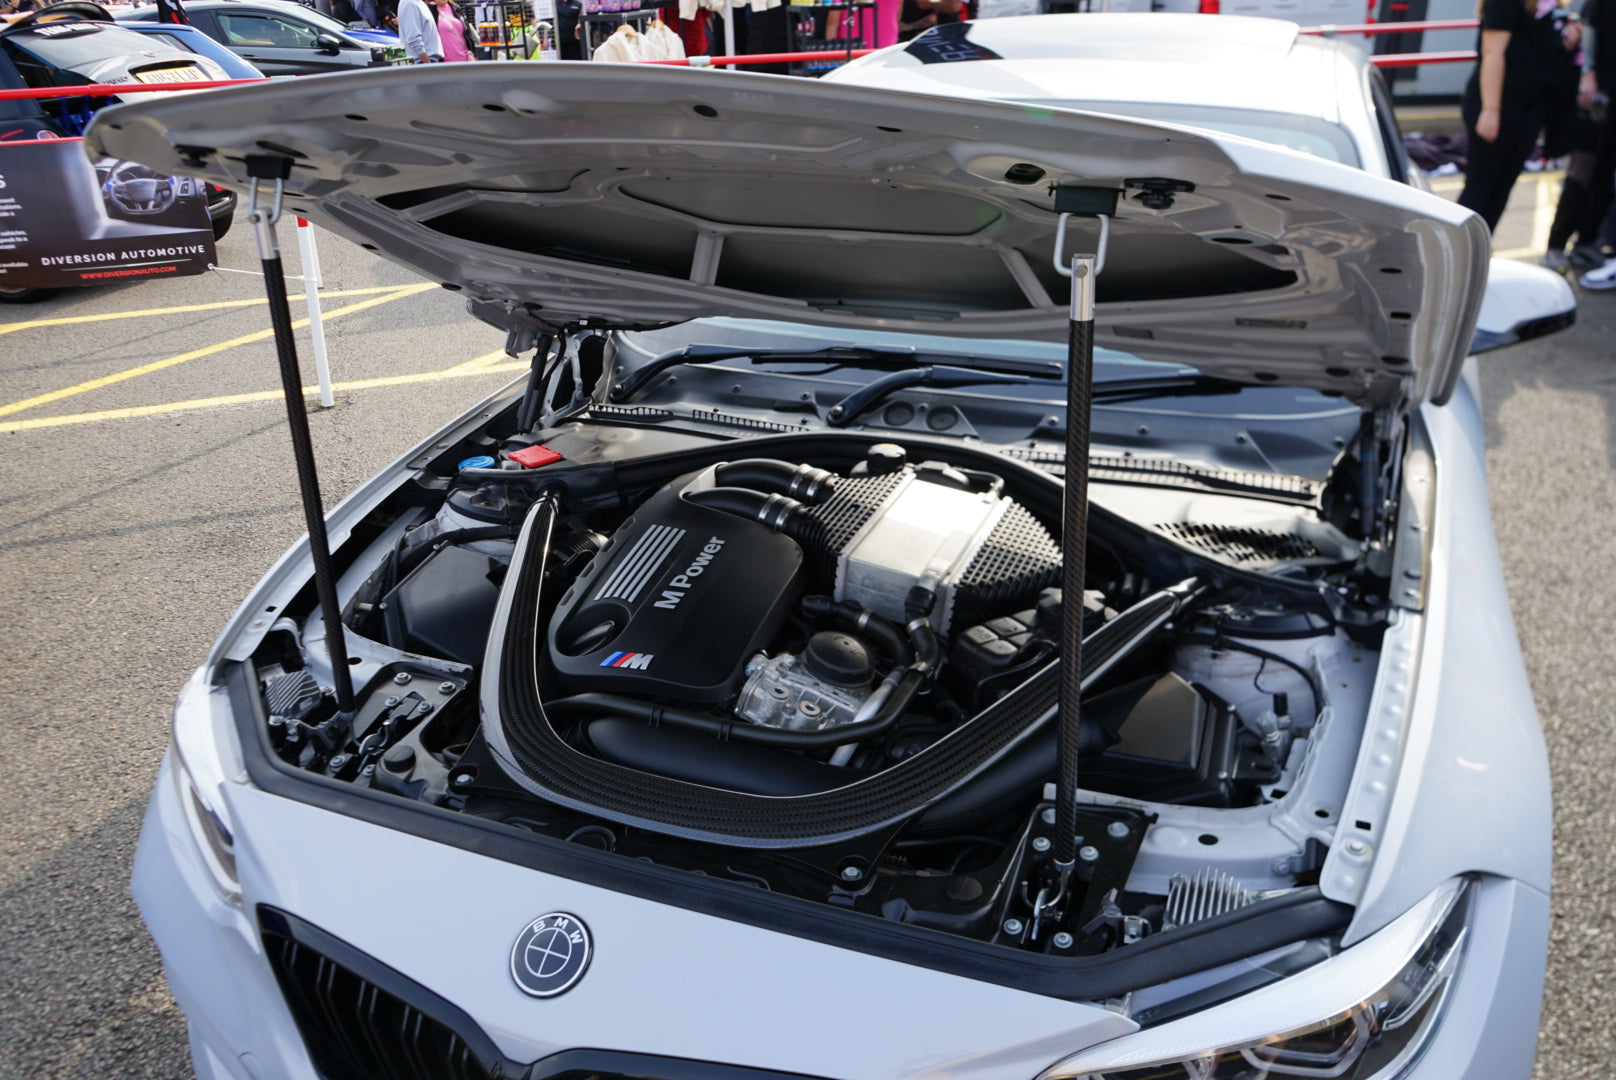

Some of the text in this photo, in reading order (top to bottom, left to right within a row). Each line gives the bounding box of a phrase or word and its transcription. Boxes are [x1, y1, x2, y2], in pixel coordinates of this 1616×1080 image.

[40, 245, 205, 266] DIVERSION AUTOMOTIVE
[80, 266, 177, 280] WWW.DIVERSIONAUTO.COM
[653, 536, 726, 610] M Power
[532, 917, 584, 944] BMW
